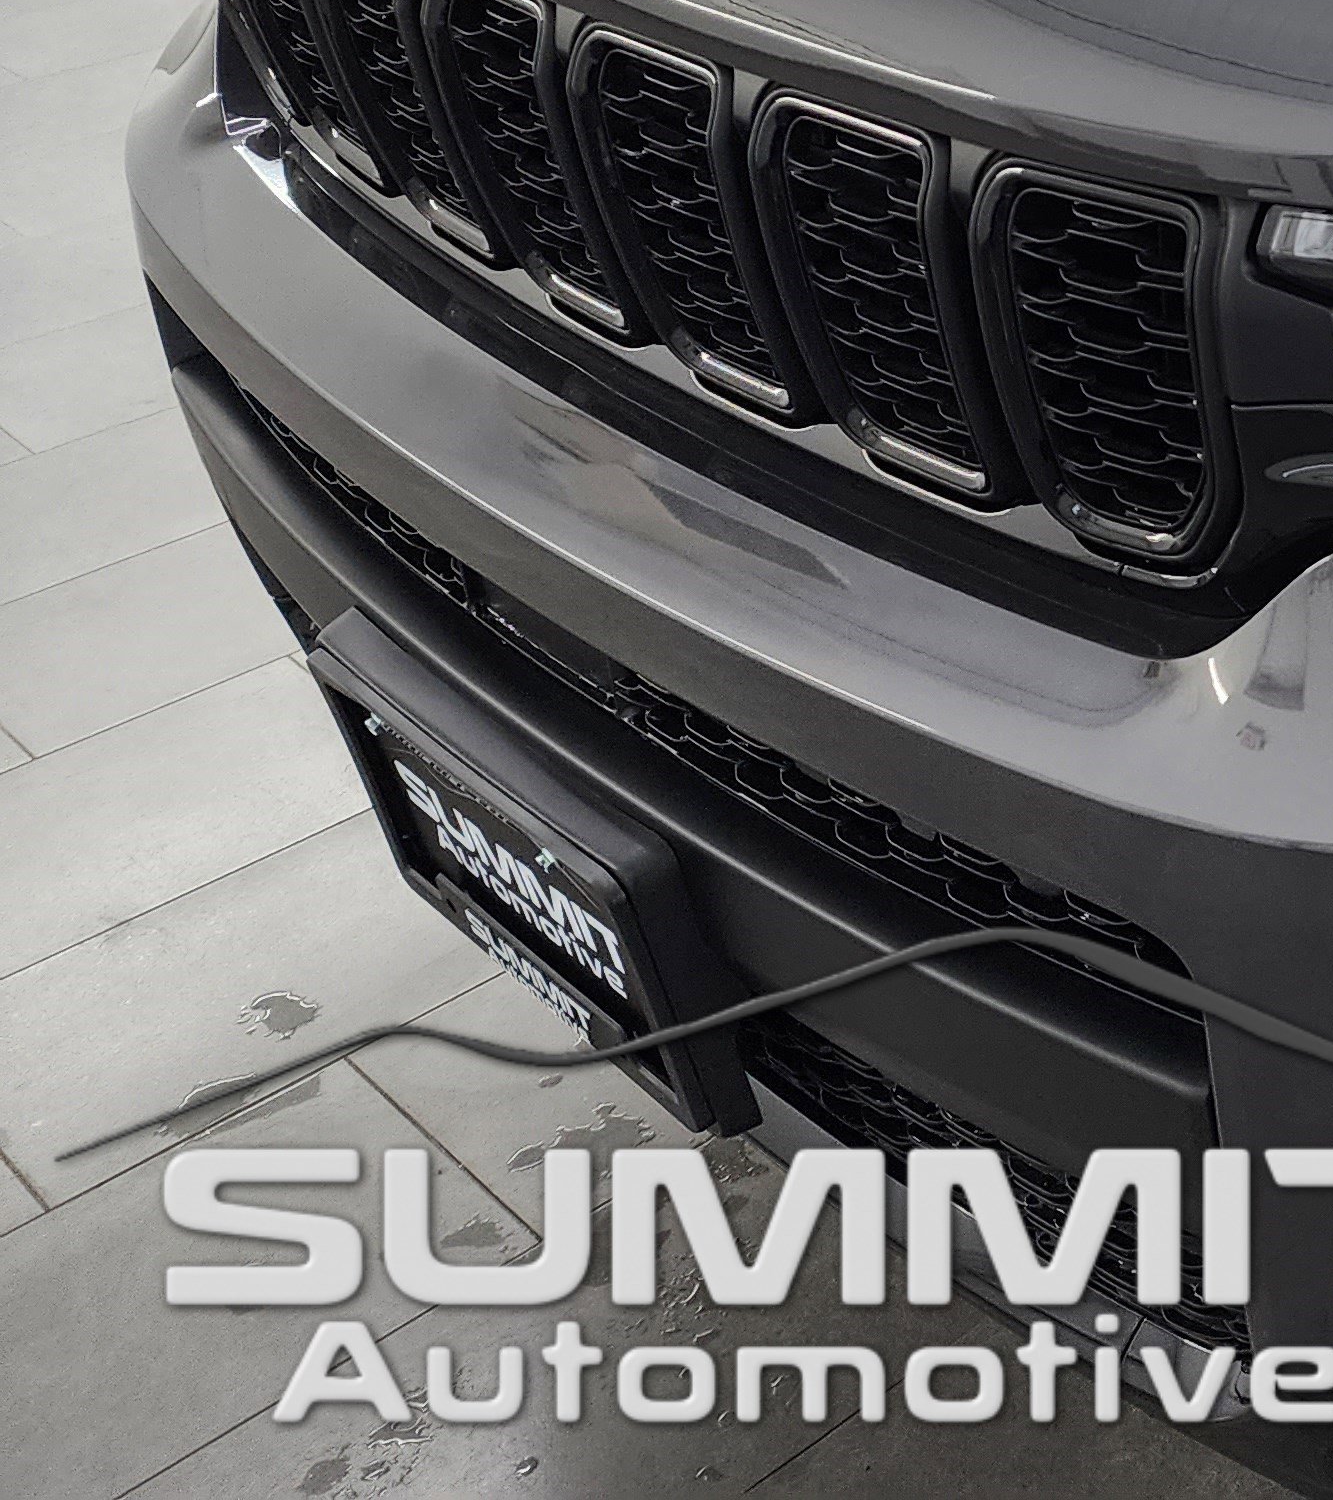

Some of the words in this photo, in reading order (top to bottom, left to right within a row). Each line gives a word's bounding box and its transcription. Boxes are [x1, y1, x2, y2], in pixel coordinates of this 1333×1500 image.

[394, 759, 625, 975] SUMMIT
[436, 824, 628, 1000] Automotive
[464, 908, 591, 1031] SUMMIT
